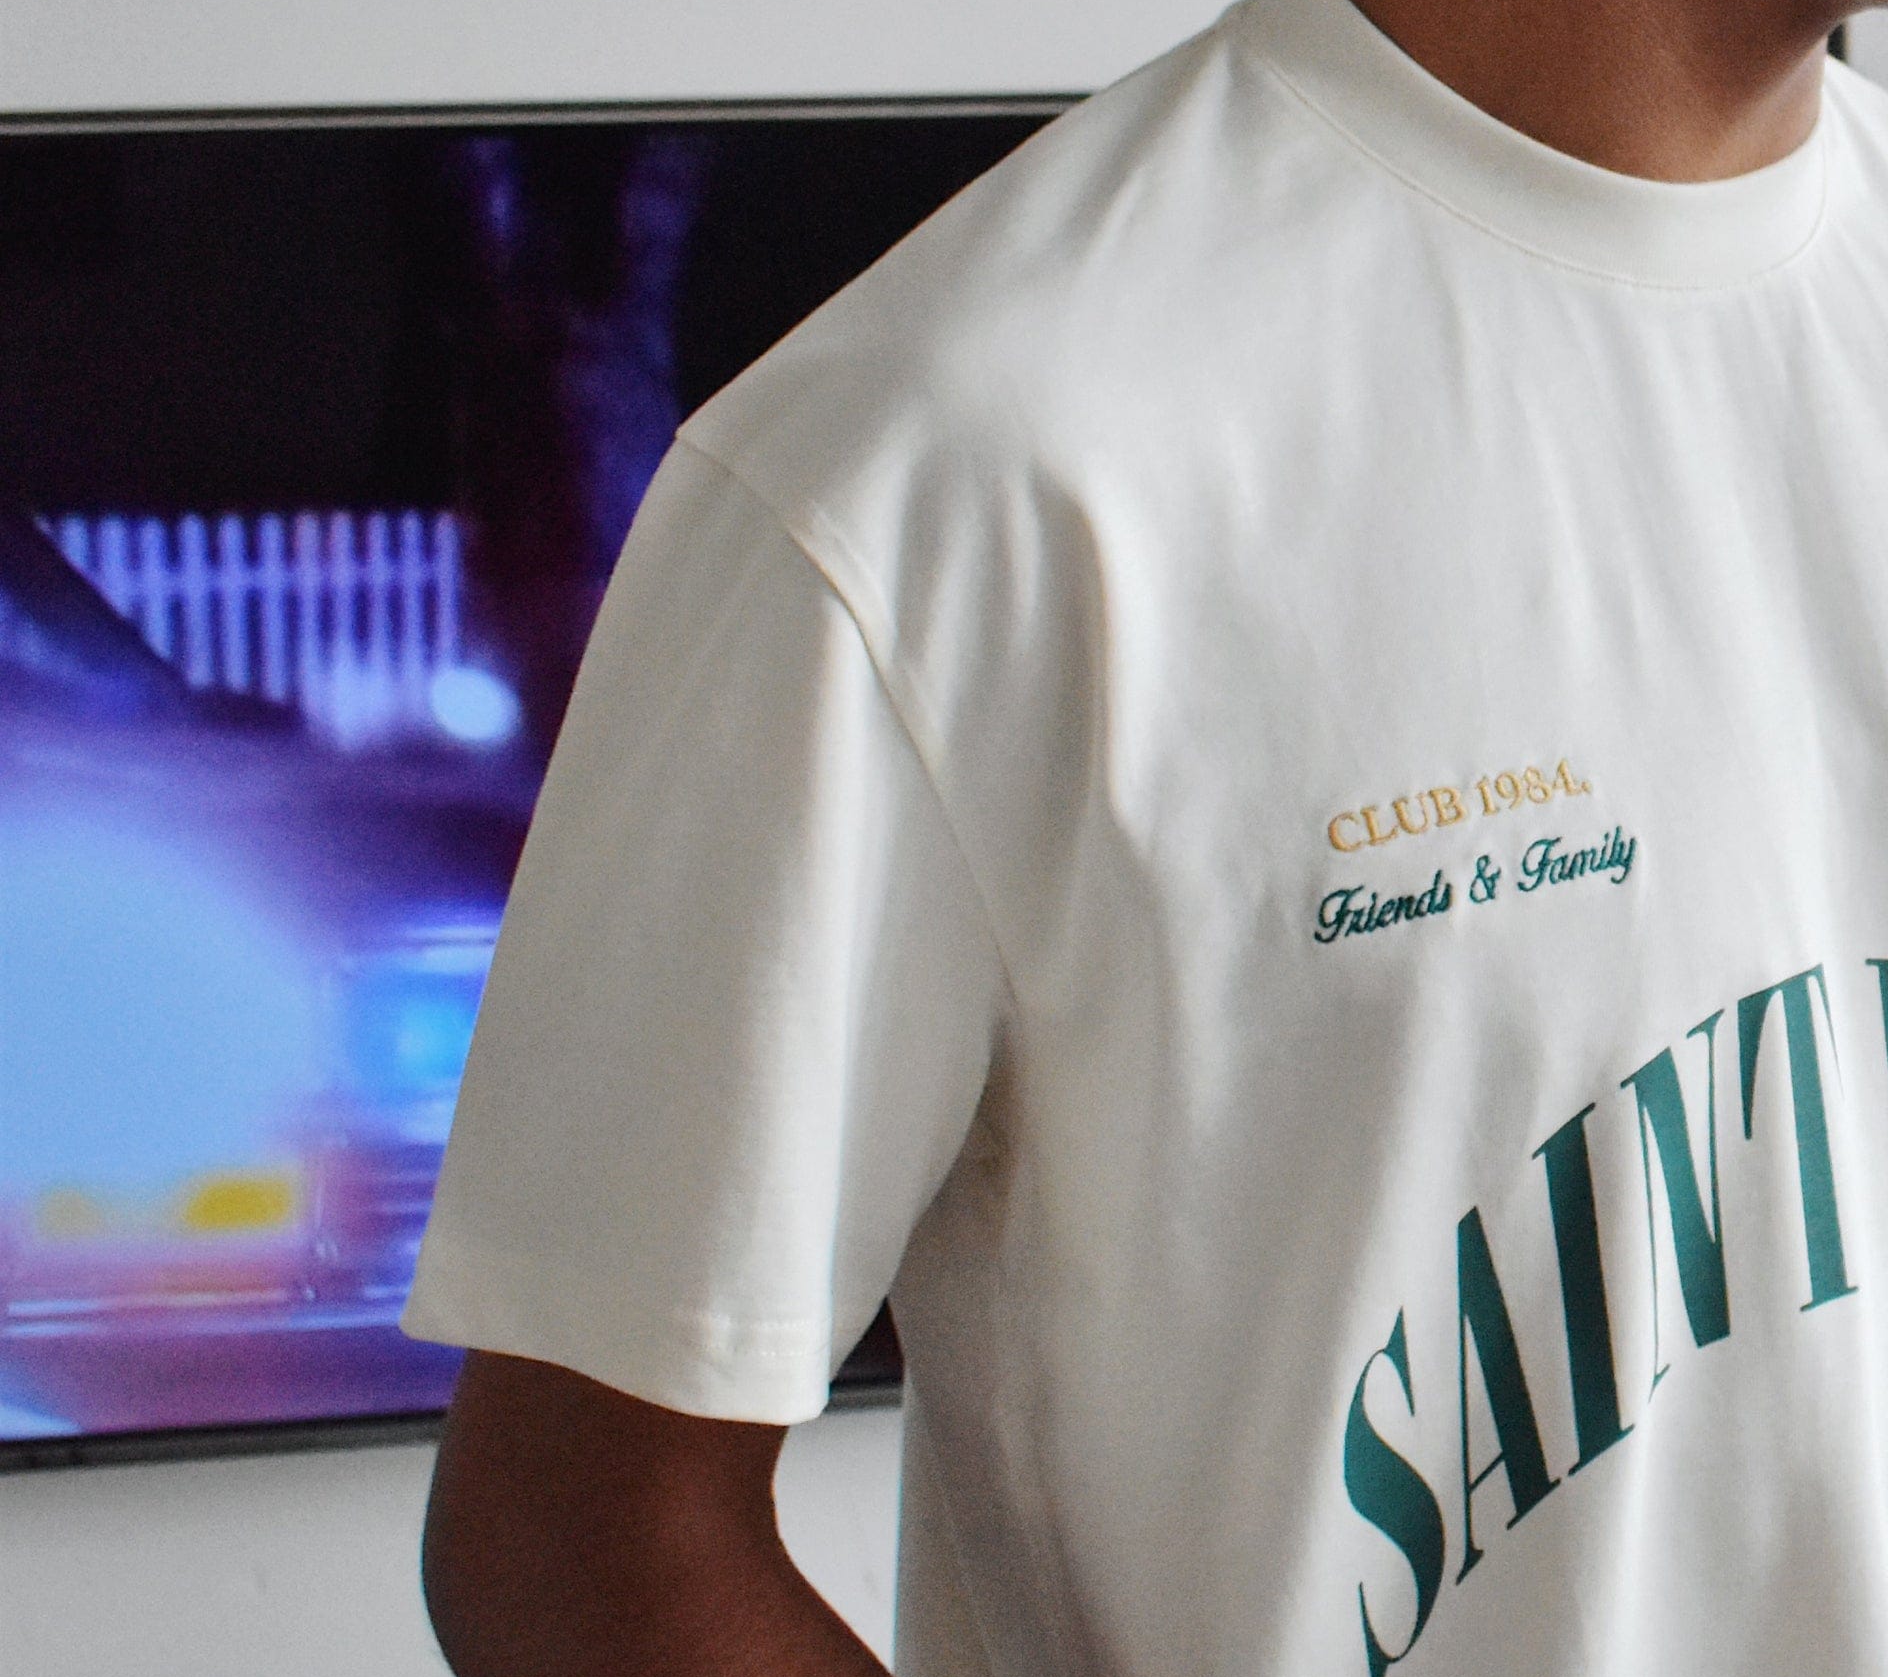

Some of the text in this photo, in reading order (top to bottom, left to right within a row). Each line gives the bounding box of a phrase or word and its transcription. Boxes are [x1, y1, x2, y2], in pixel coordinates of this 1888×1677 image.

[1327, 785, 1469, 853] CLUB
[1314, 825, 1638, 944] Friends & Family
